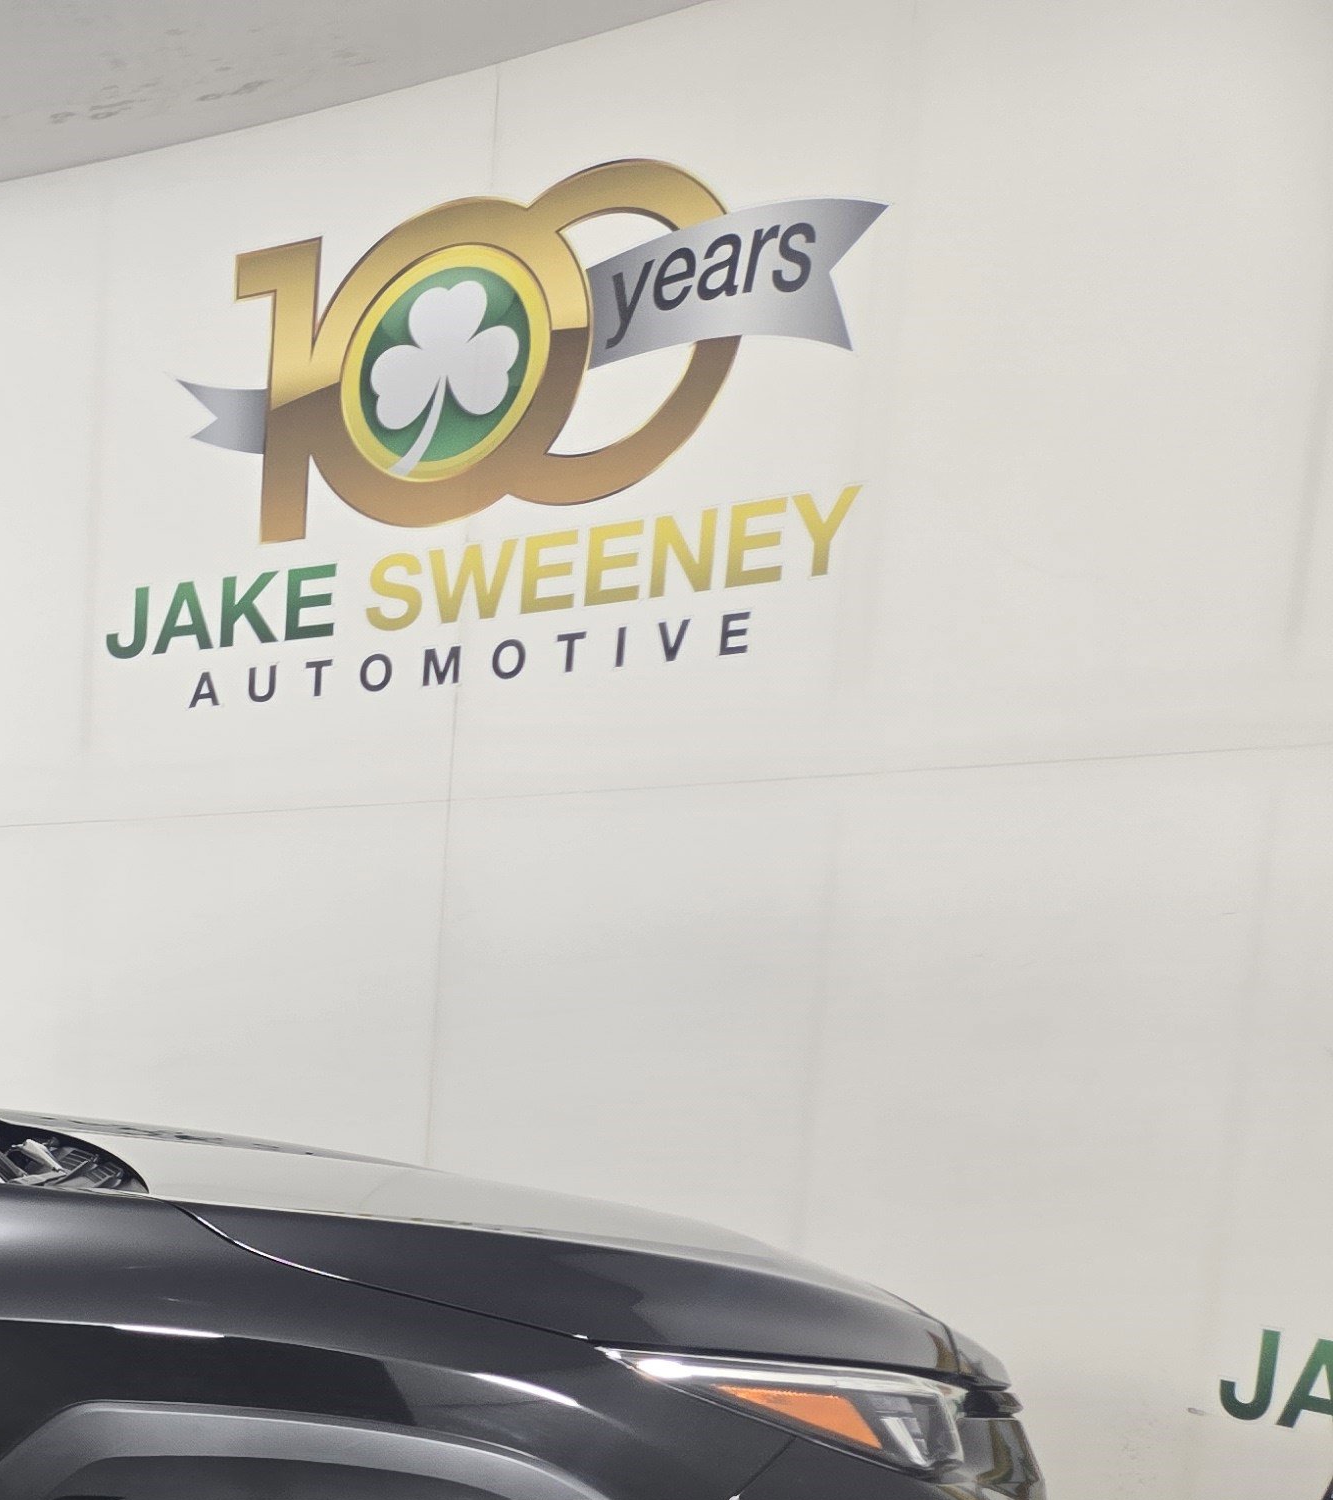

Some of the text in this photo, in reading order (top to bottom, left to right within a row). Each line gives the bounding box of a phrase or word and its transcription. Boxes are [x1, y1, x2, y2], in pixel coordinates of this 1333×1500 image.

[606, 221, 817, 350] years
[105, 485, 862, 660] JAKE SWEENEY
[189, 611, 752, 709] AUTOMOTIVE
